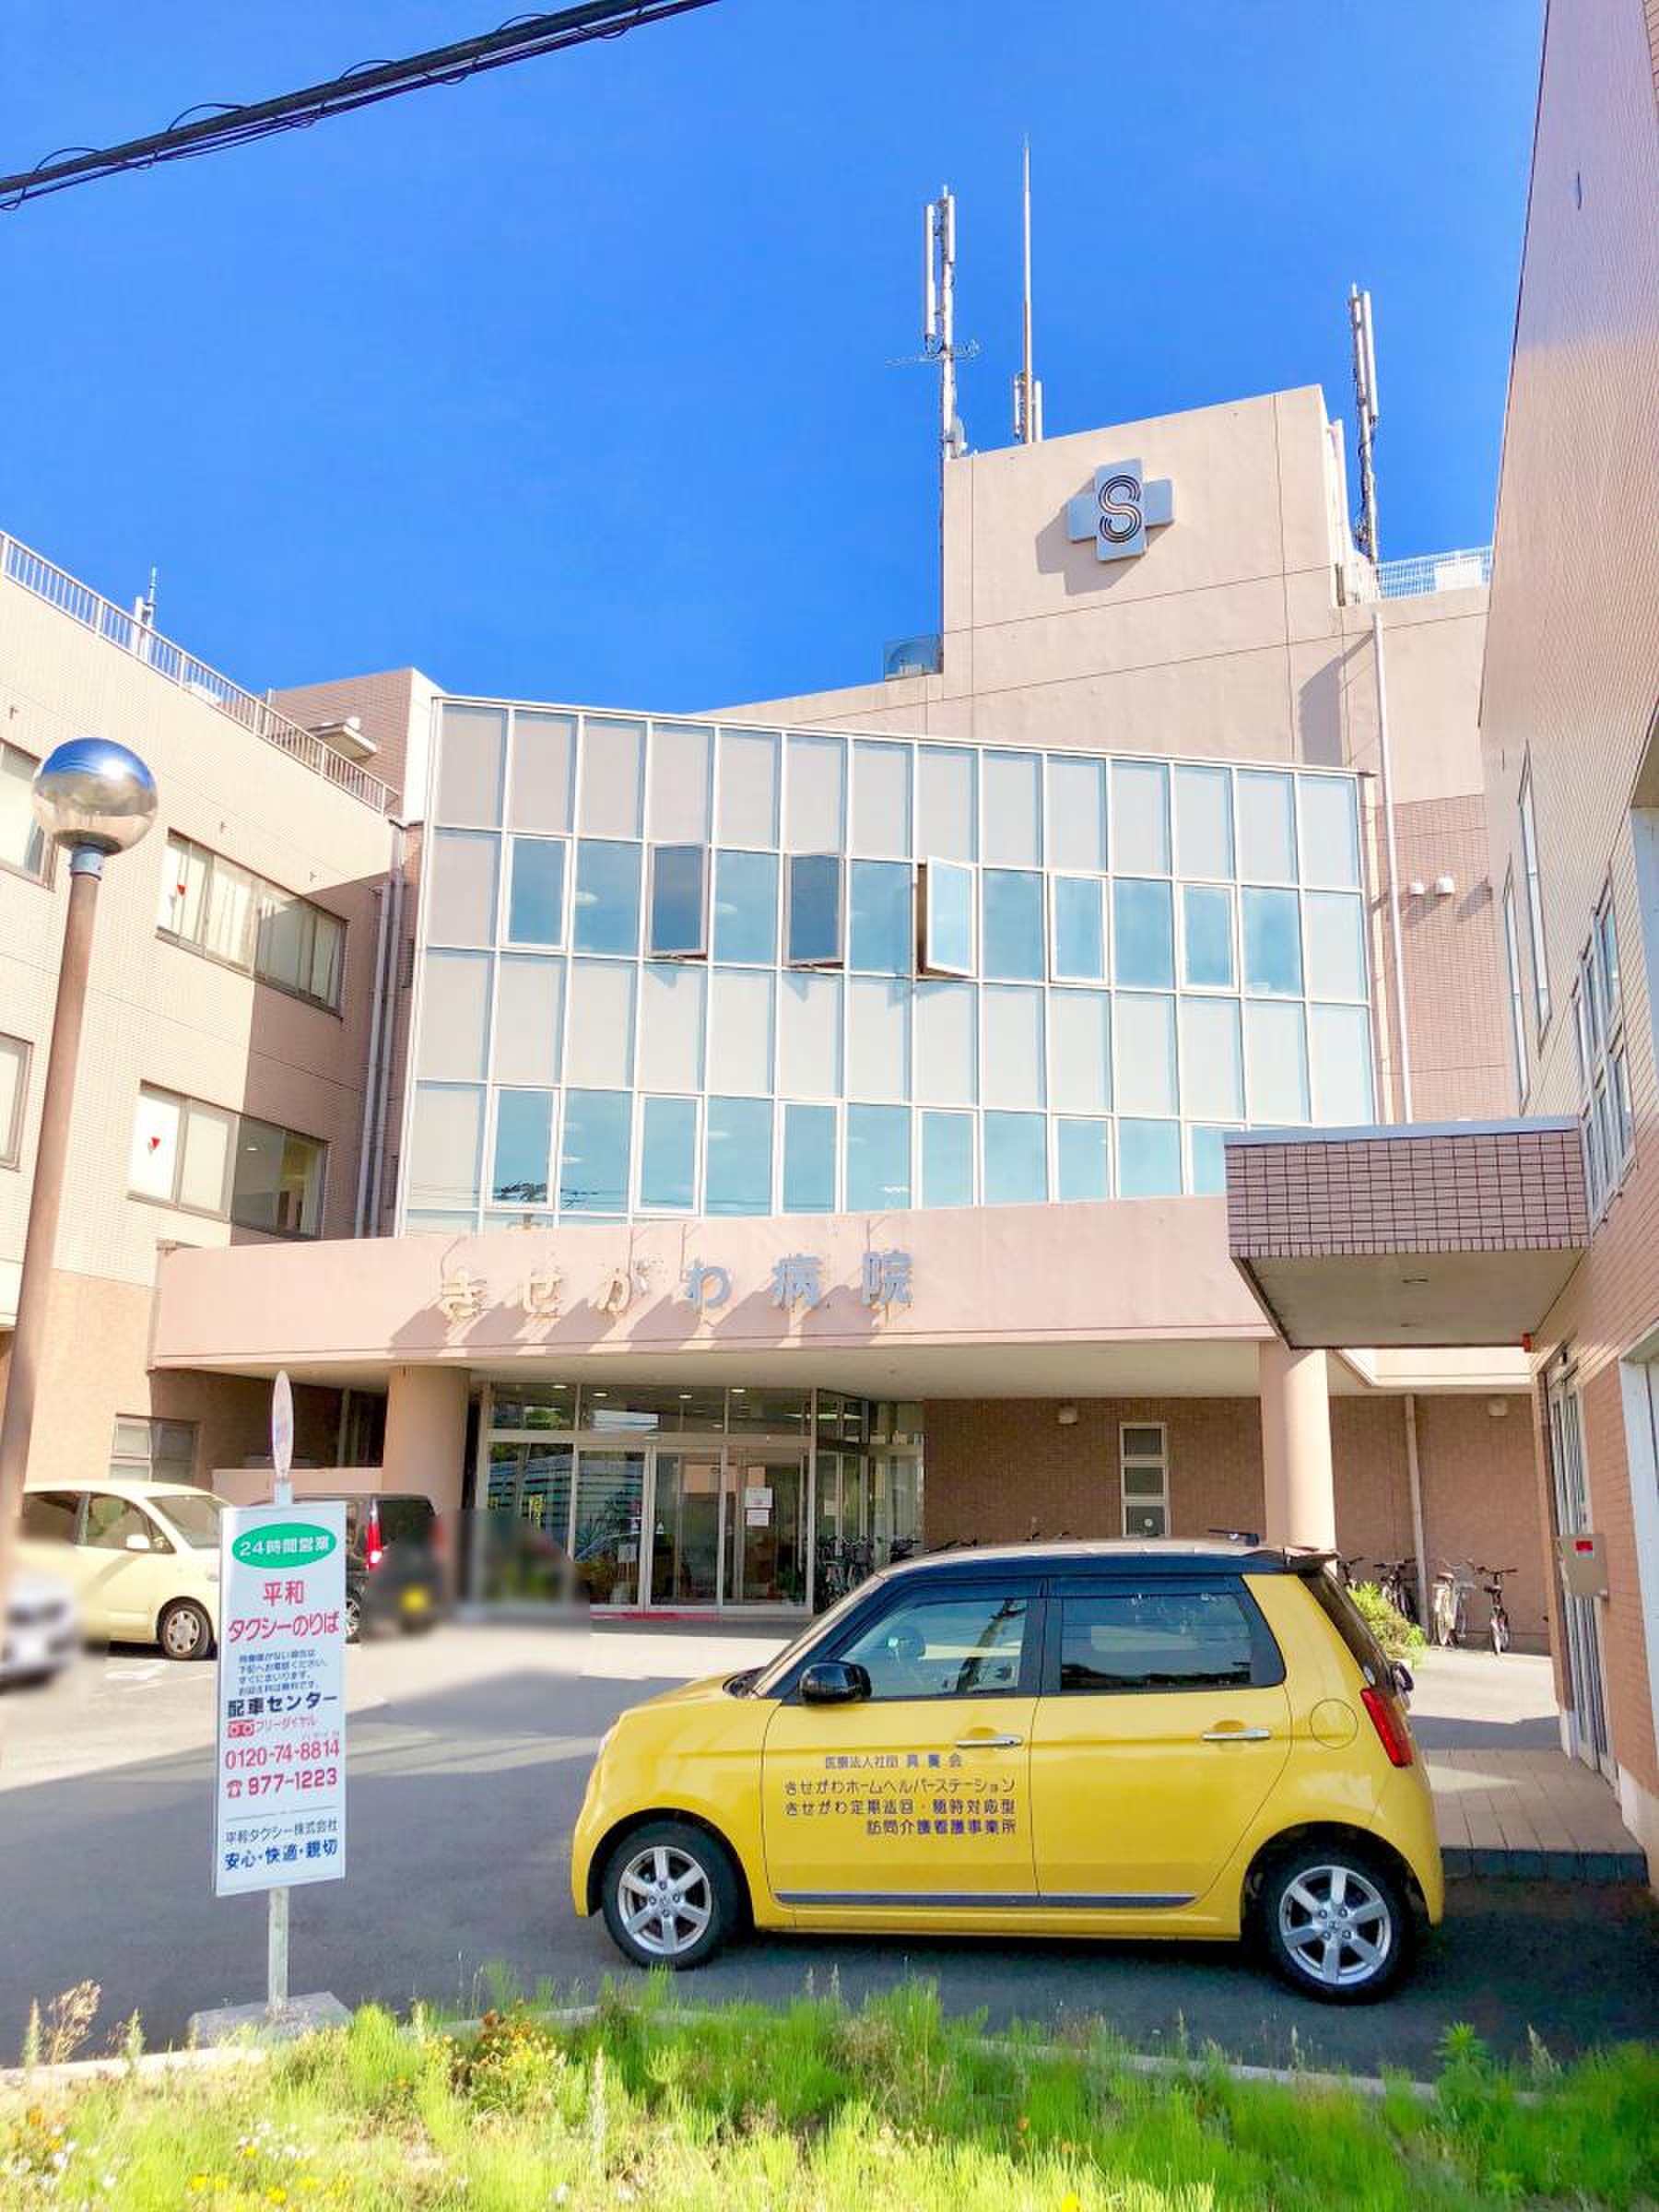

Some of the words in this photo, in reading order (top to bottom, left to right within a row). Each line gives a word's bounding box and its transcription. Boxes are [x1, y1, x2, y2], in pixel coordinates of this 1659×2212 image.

[1099, 475, 1142, 543] S
[441, 1249, 915, 1319] きせがわ病院
[240, 1536, 330, 1557] 24時間営業
[263, 1580, 305, 1606] 平和
[229, 1611, 340, 1642] タクシーのりば
[228, 1691, 338, 1718] 配車センター
[225, 1739, 340, 1770] 0120-74-8814
[784, 1778, 1016, 1795] きせがわホームヘルパーステーション
